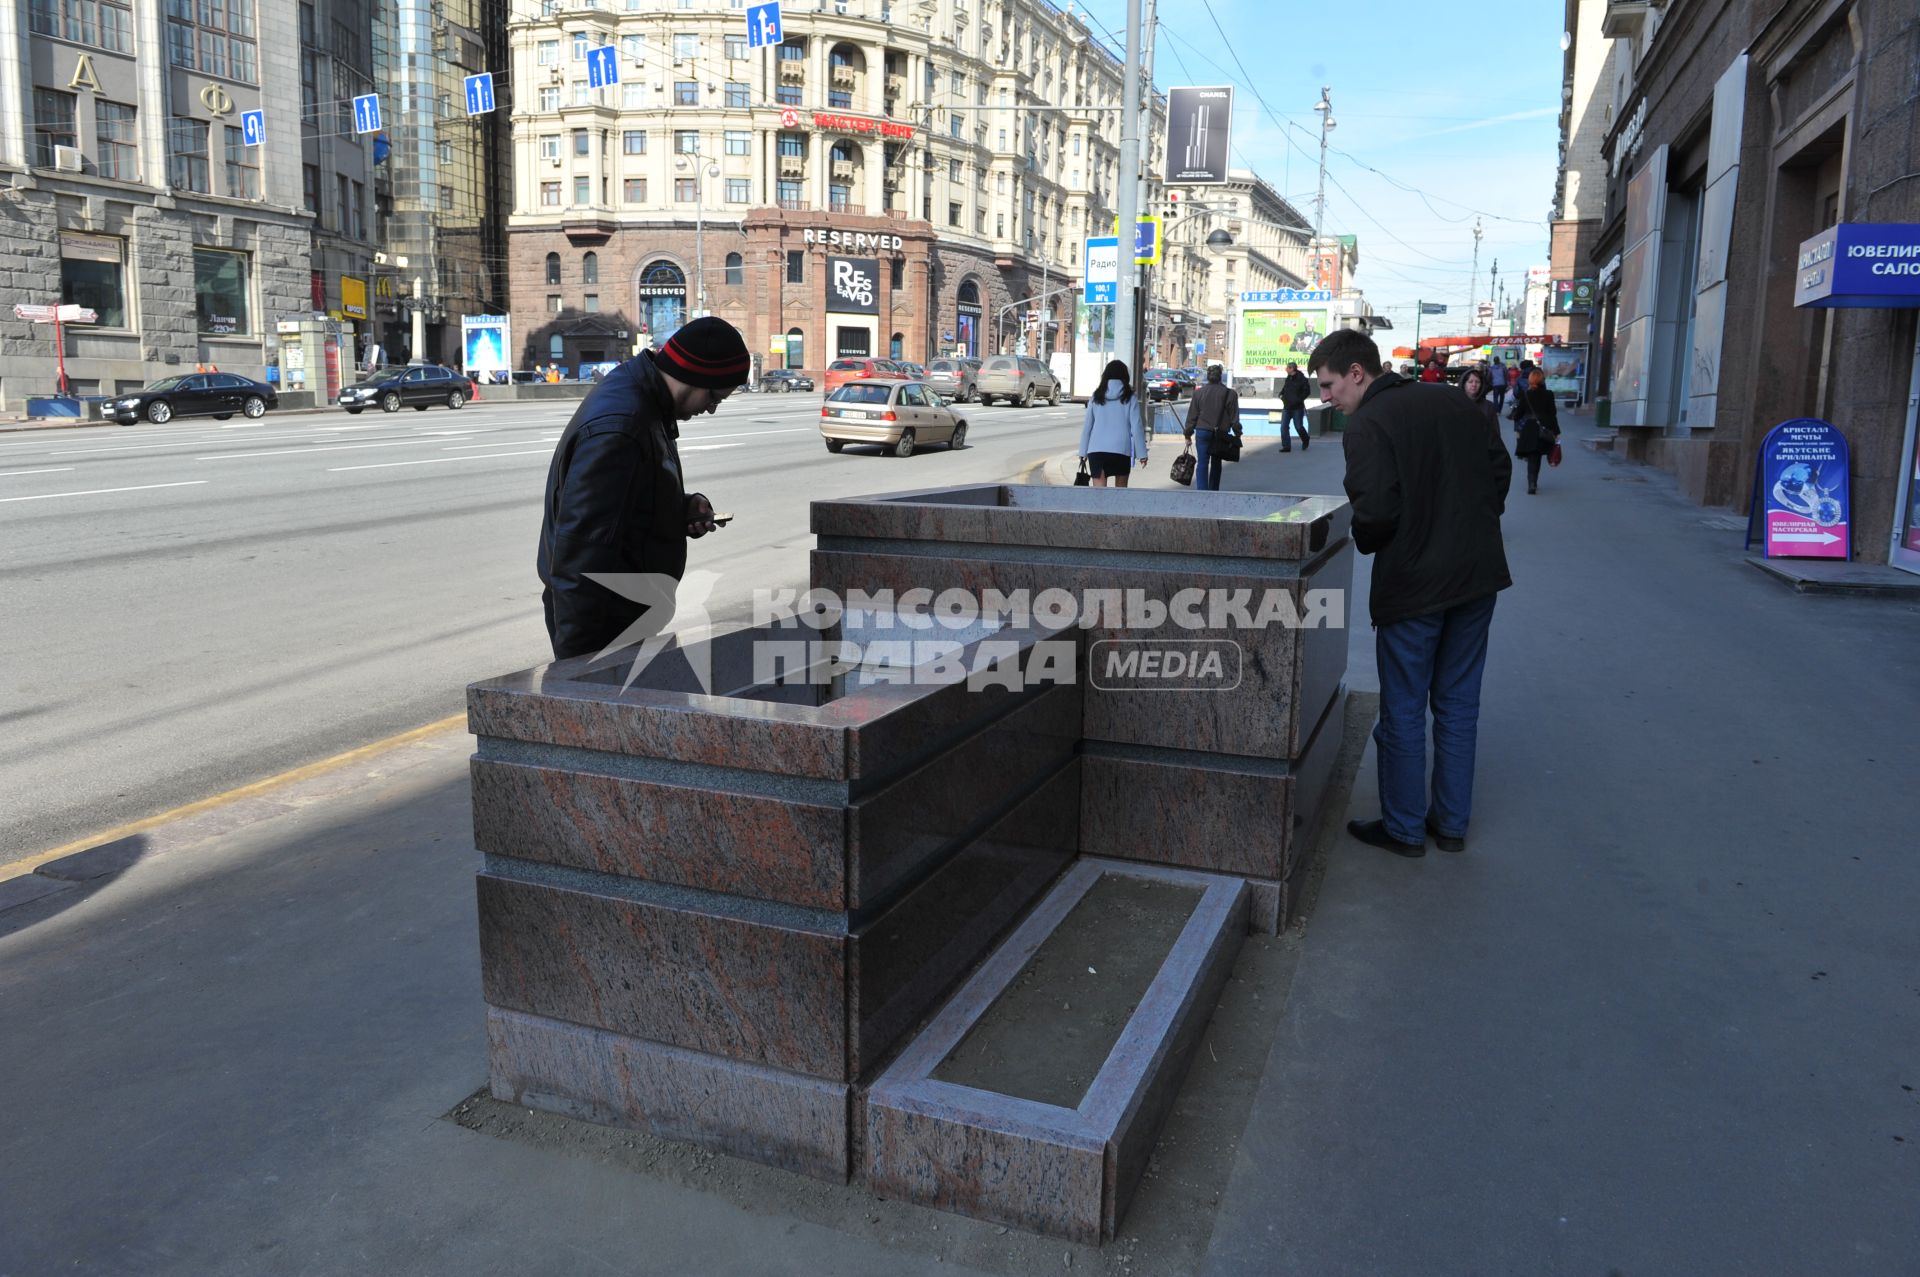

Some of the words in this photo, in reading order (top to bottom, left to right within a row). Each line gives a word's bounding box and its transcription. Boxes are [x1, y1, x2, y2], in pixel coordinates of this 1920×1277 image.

[200, 82, 232, 117] Ф
[803, 229, 902, 250] RESERVED
[1848, 245, 1920, 258] ЮВЕЛИР
[1091, 259, 1117, 269] Радио
[1872, 262, 1920, 275] САЛО
[1095, 284, 1110, 292] 100,1
[1095, 294, 1109, 302] МГц
[958, 304, 982, 314] RESERVED
